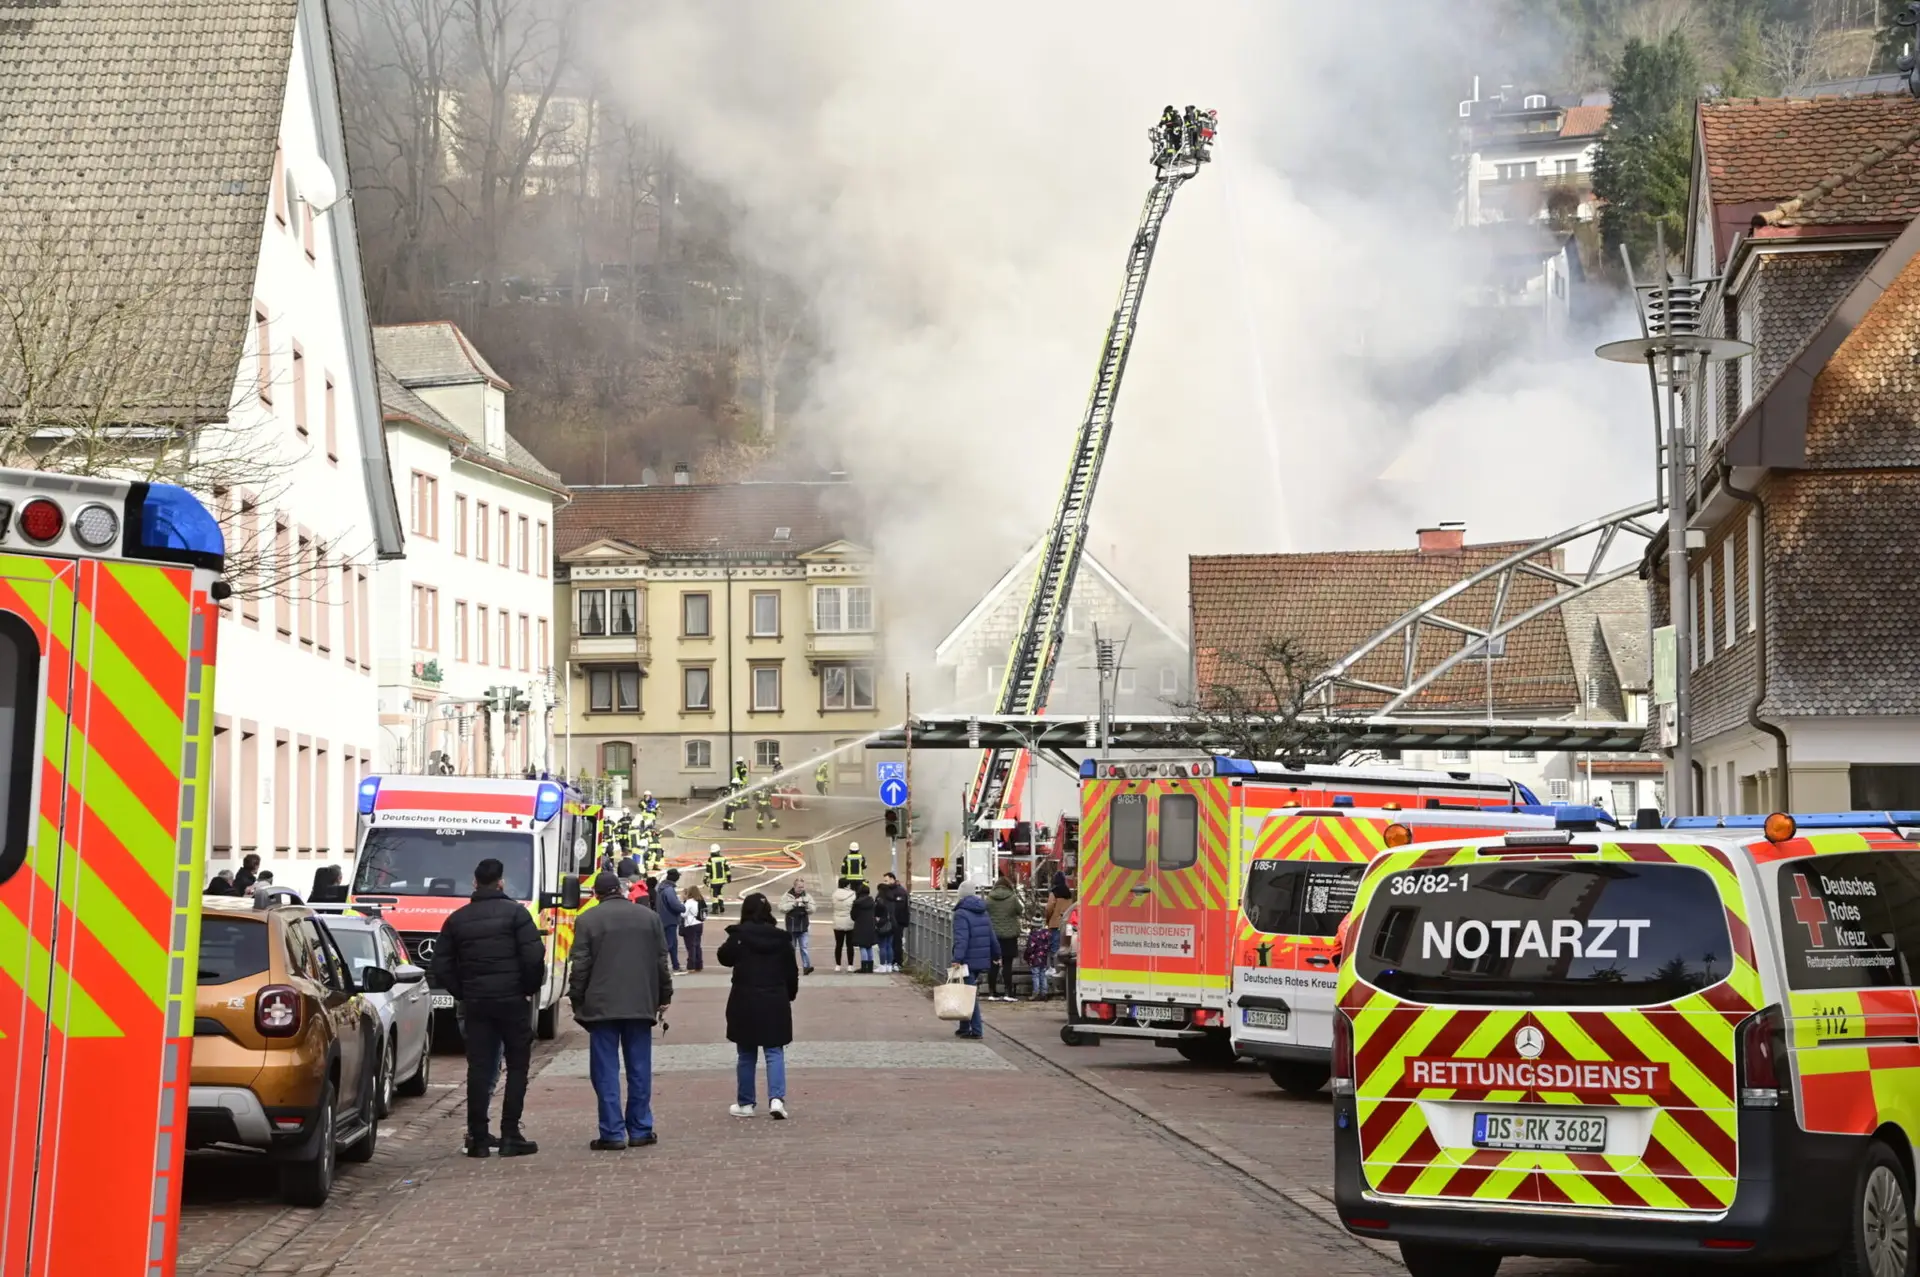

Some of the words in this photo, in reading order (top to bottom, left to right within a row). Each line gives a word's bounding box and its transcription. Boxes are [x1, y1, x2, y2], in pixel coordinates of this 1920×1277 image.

[382, 813, 436, 823] Deutsches
[439, 815, 468, 824] Rotes
[471, 816, 501, 825] Kreuz
[1390, 873, 1469, 895] 36/82-1
[1820, 875, 1877, 896] Deutsches
[1828, 901, 1861, 920] Rotes
[1112, 924, 1191, 937] RETTUNGSDIENST
[1422, 919, 1650, 959] NOTARZT
[1834, 926, 1868, 946] Kreuz
[1112, 939, 1142, 949] Deutsches
[1143, 940, 1160, 949] Rotes
[1161, 941, 1179, 949] Kreuz
[1806, 955, 1850, 971] Rettungsdienst
[1243, 973, 1283, 985] Deutsches
[1285, 976, 1309, 988] Rotes
[1311, 978, 1337, 989] Kreuz
[1822, 1006, 1848, 1035] 112
[1413, 1061, 1659, 1090] RETTUNGSDIENST
[1487, 1117, 1511, 1139] DS
[1526, 1118, 1550, 1140] RK
[1555, 1119, 1602, 1142] 3682
